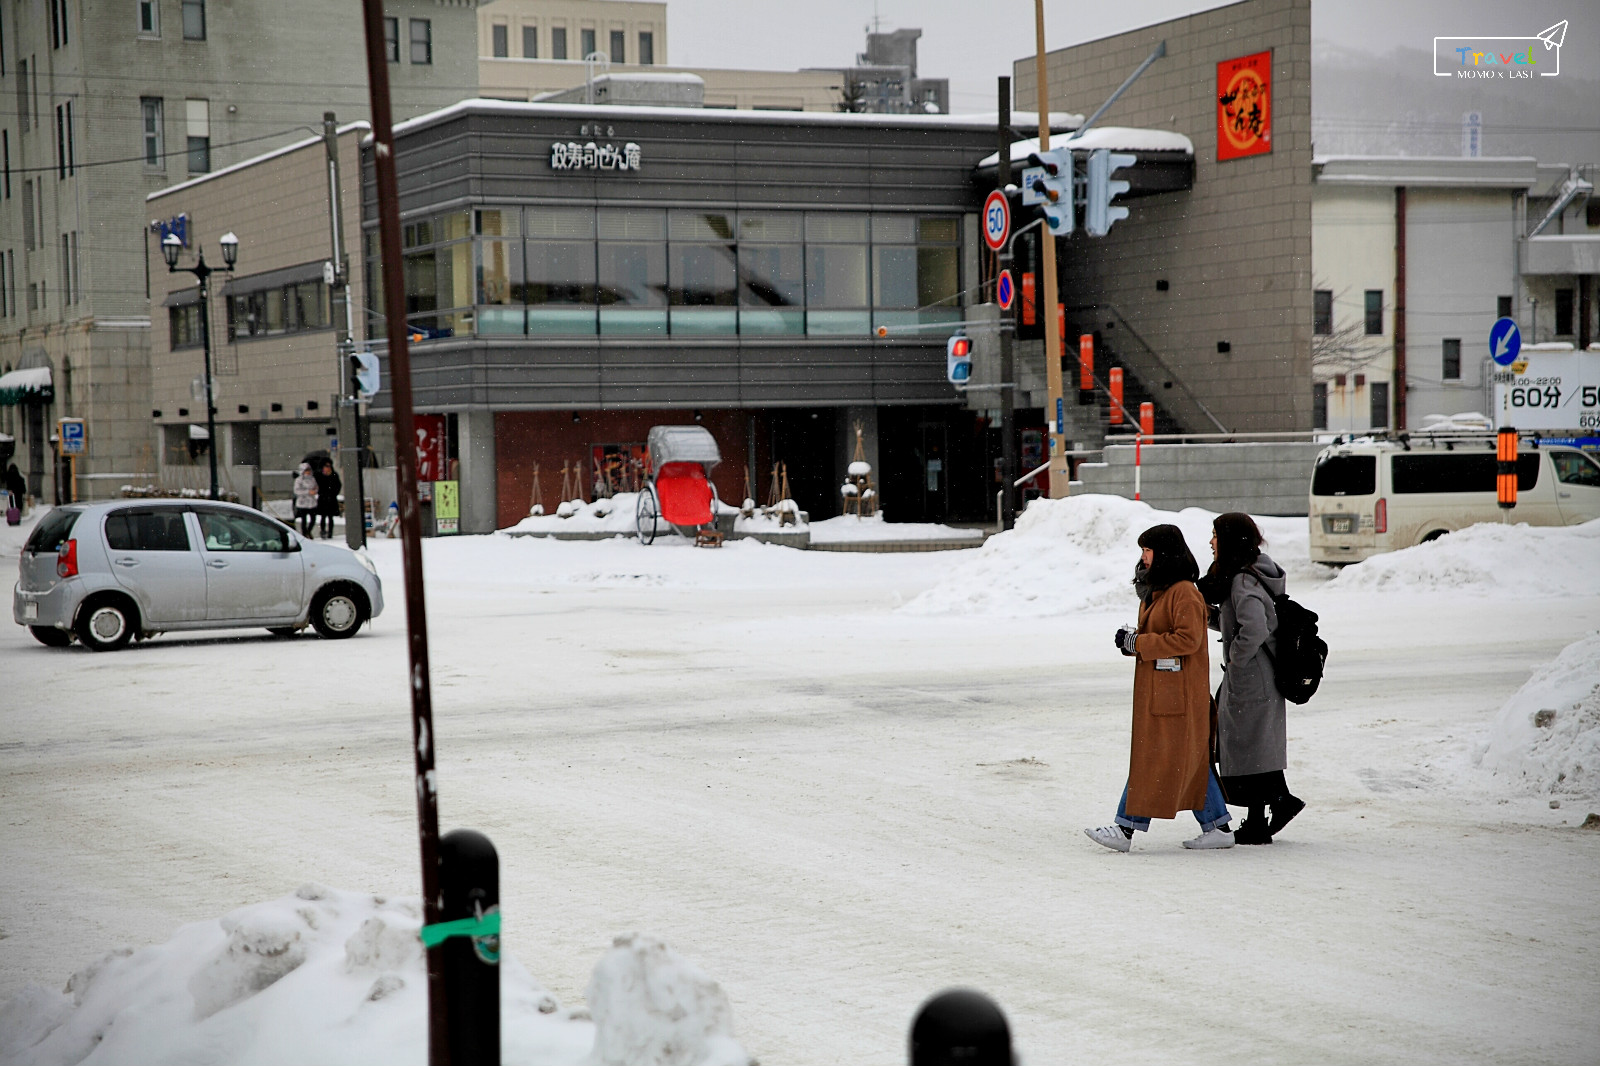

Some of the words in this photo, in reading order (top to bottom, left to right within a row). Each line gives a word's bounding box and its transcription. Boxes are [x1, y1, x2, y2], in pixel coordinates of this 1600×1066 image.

[552, 142, 641, 169] 政寿司ぜん庵
[988, 207, 1004, 234] 50
[1511, 386, 1562, 409] 60分
[1582, 386, 1600, 408] 5
[65, 424, 80, 437] P
